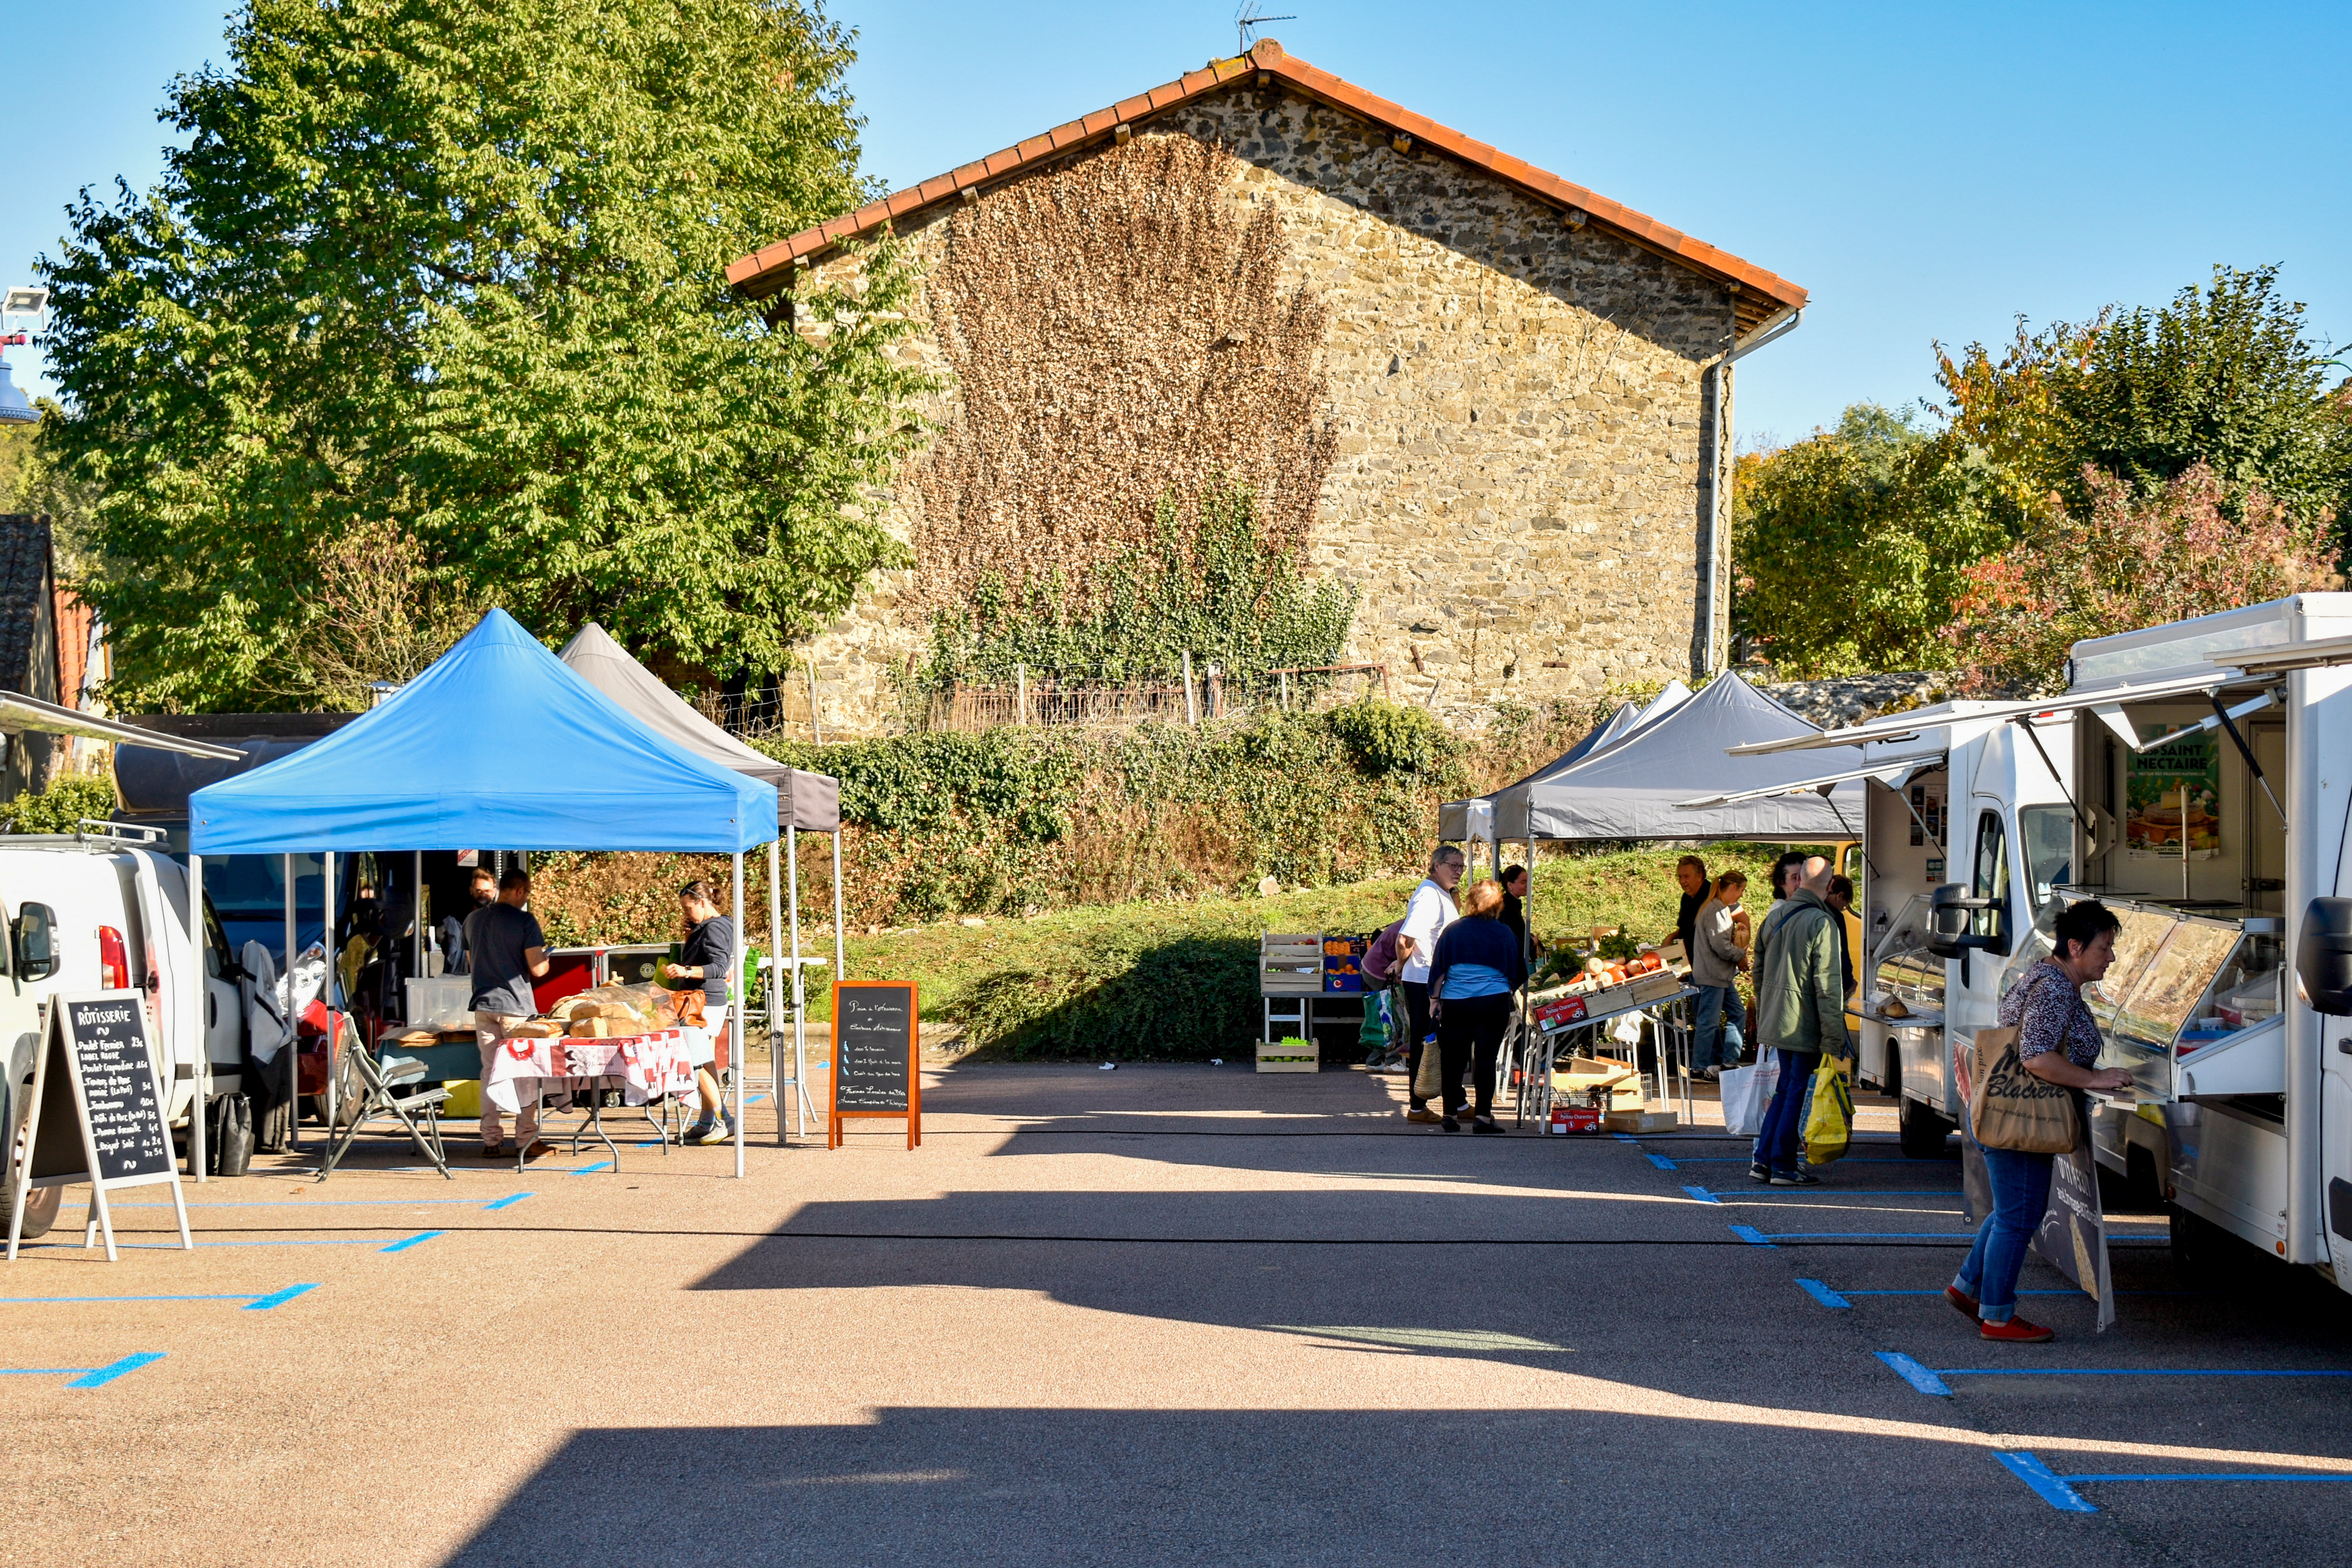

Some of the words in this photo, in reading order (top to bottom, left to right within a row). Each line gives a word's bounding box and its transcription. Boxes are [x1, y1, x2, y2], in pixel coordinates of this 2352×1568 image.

[2161, 745, 2203, 756] SAINT
[2137, 758, 2208, 769] NECTAIRE
[849, 1000, 867, 1012] Pain
[1545, 1002, 1579, 1014] Poitou-Charentes
[81, 1053, 99, 1061] LABEL
[100, 1051, 120, 1060] ROUGE
[866, 1086, 887, 1094] Locales
[1992, 1105, 2003, 1113] bon
[2003, 1108, 2027, 1119] produit
